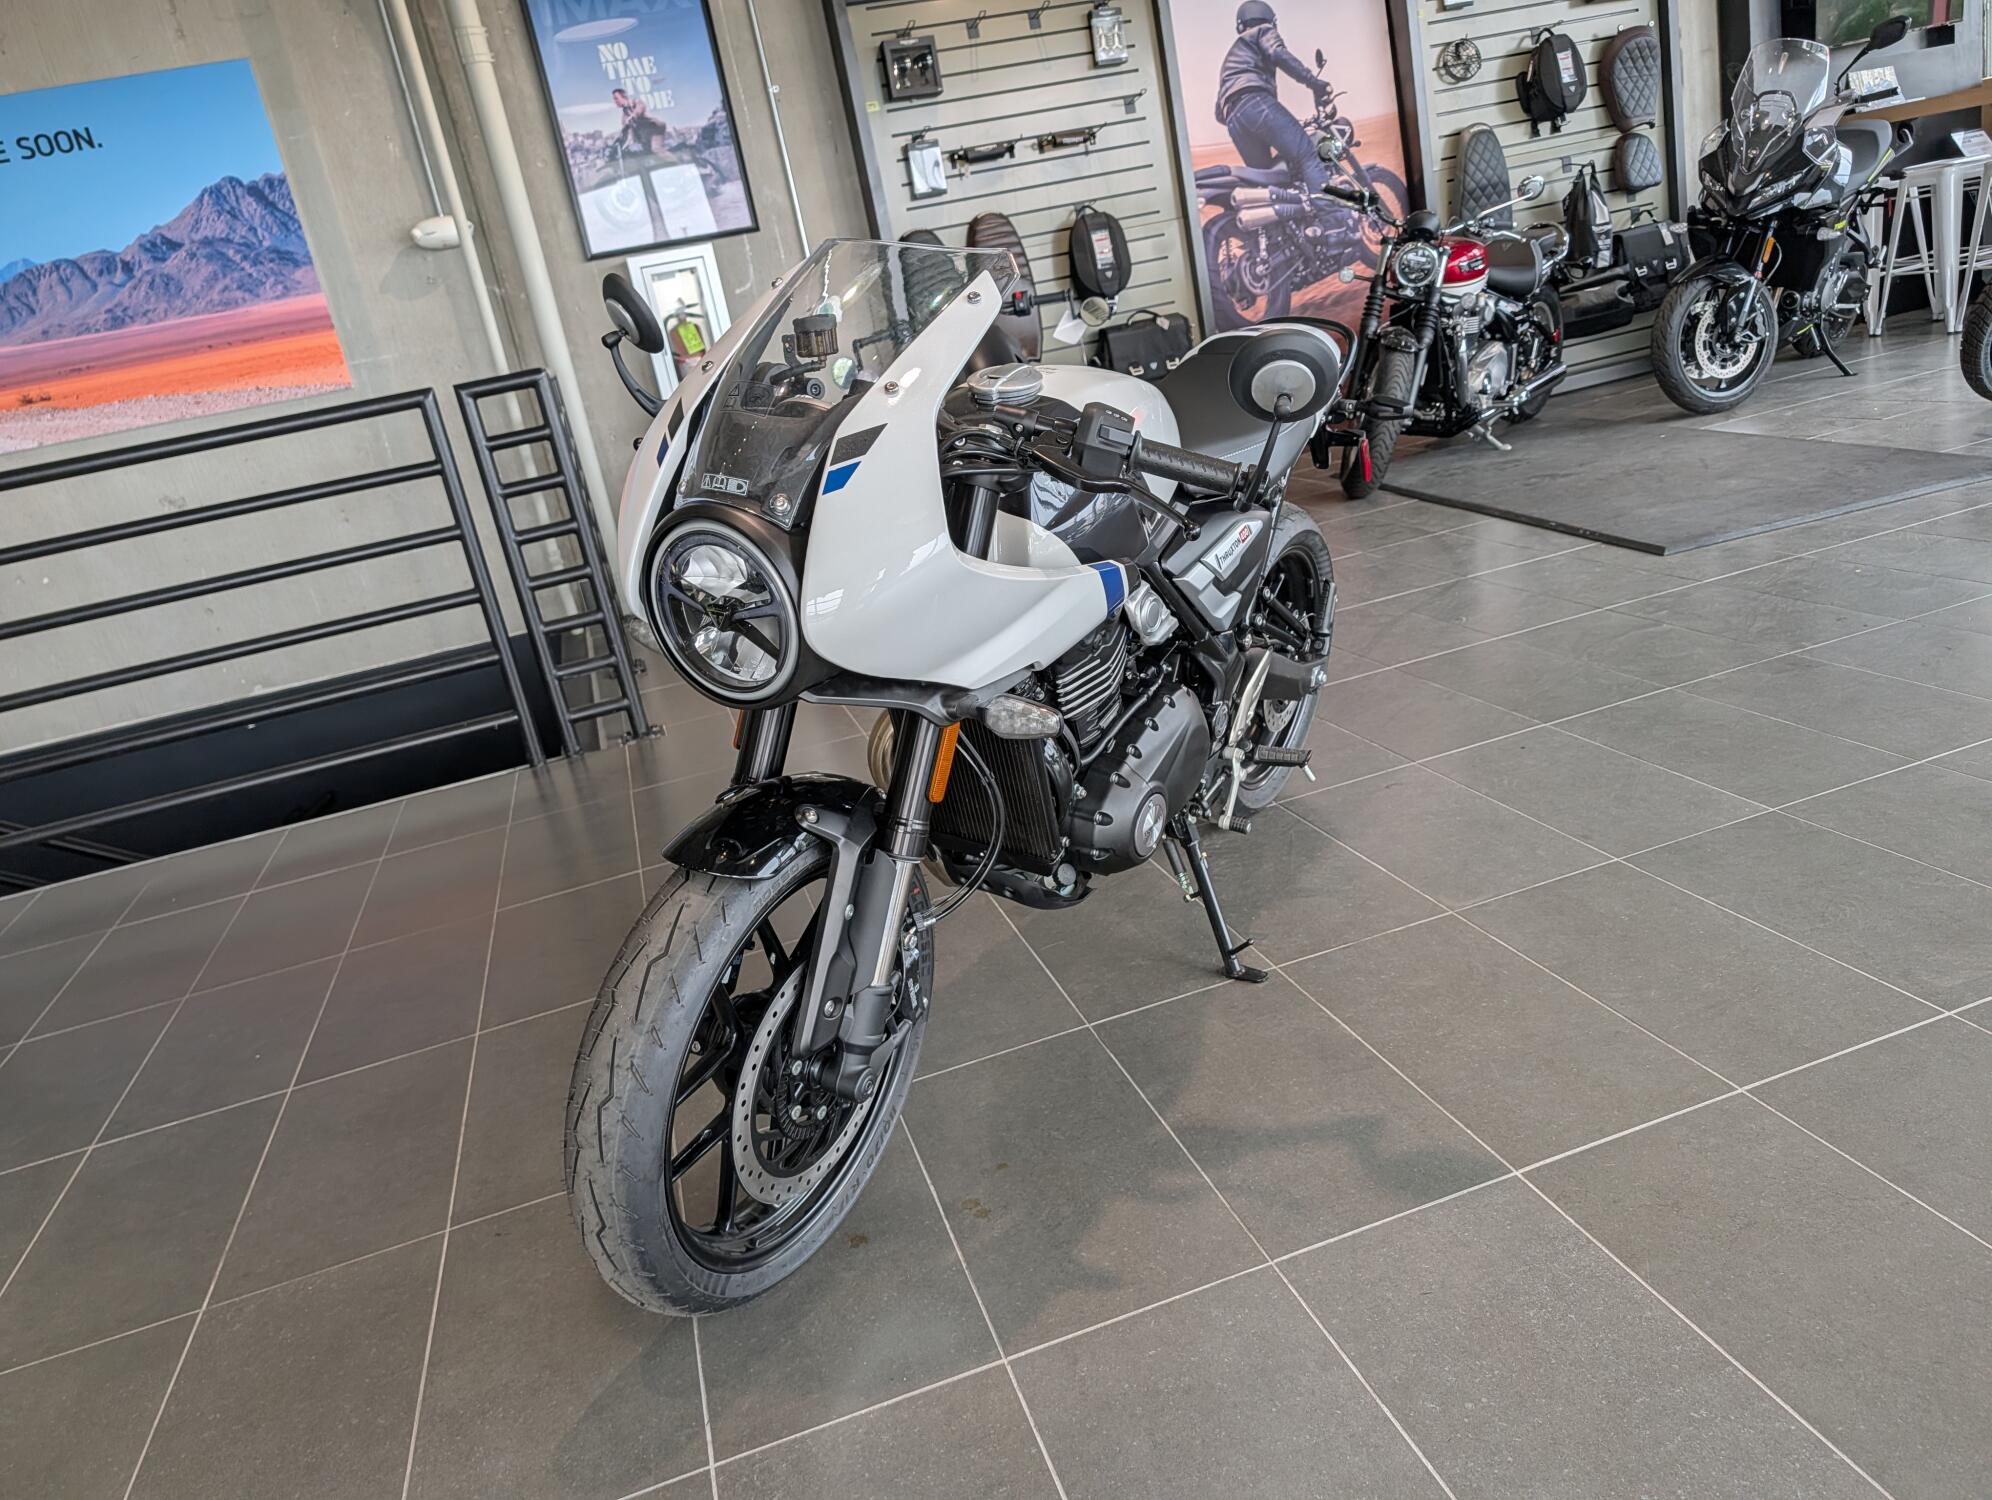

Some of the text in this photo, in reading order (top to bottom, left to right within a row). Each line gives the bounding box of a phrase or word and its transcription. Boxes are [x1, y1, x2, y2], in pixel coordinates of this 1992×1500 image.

[598, 42, 629, 63] NO
[602, 56, 657, 80] TIME
[621, 76, 651, 96] TO
[16, 127, 103, 160] SOON.
[1219, 536, 1241, 565] THRUXTON
